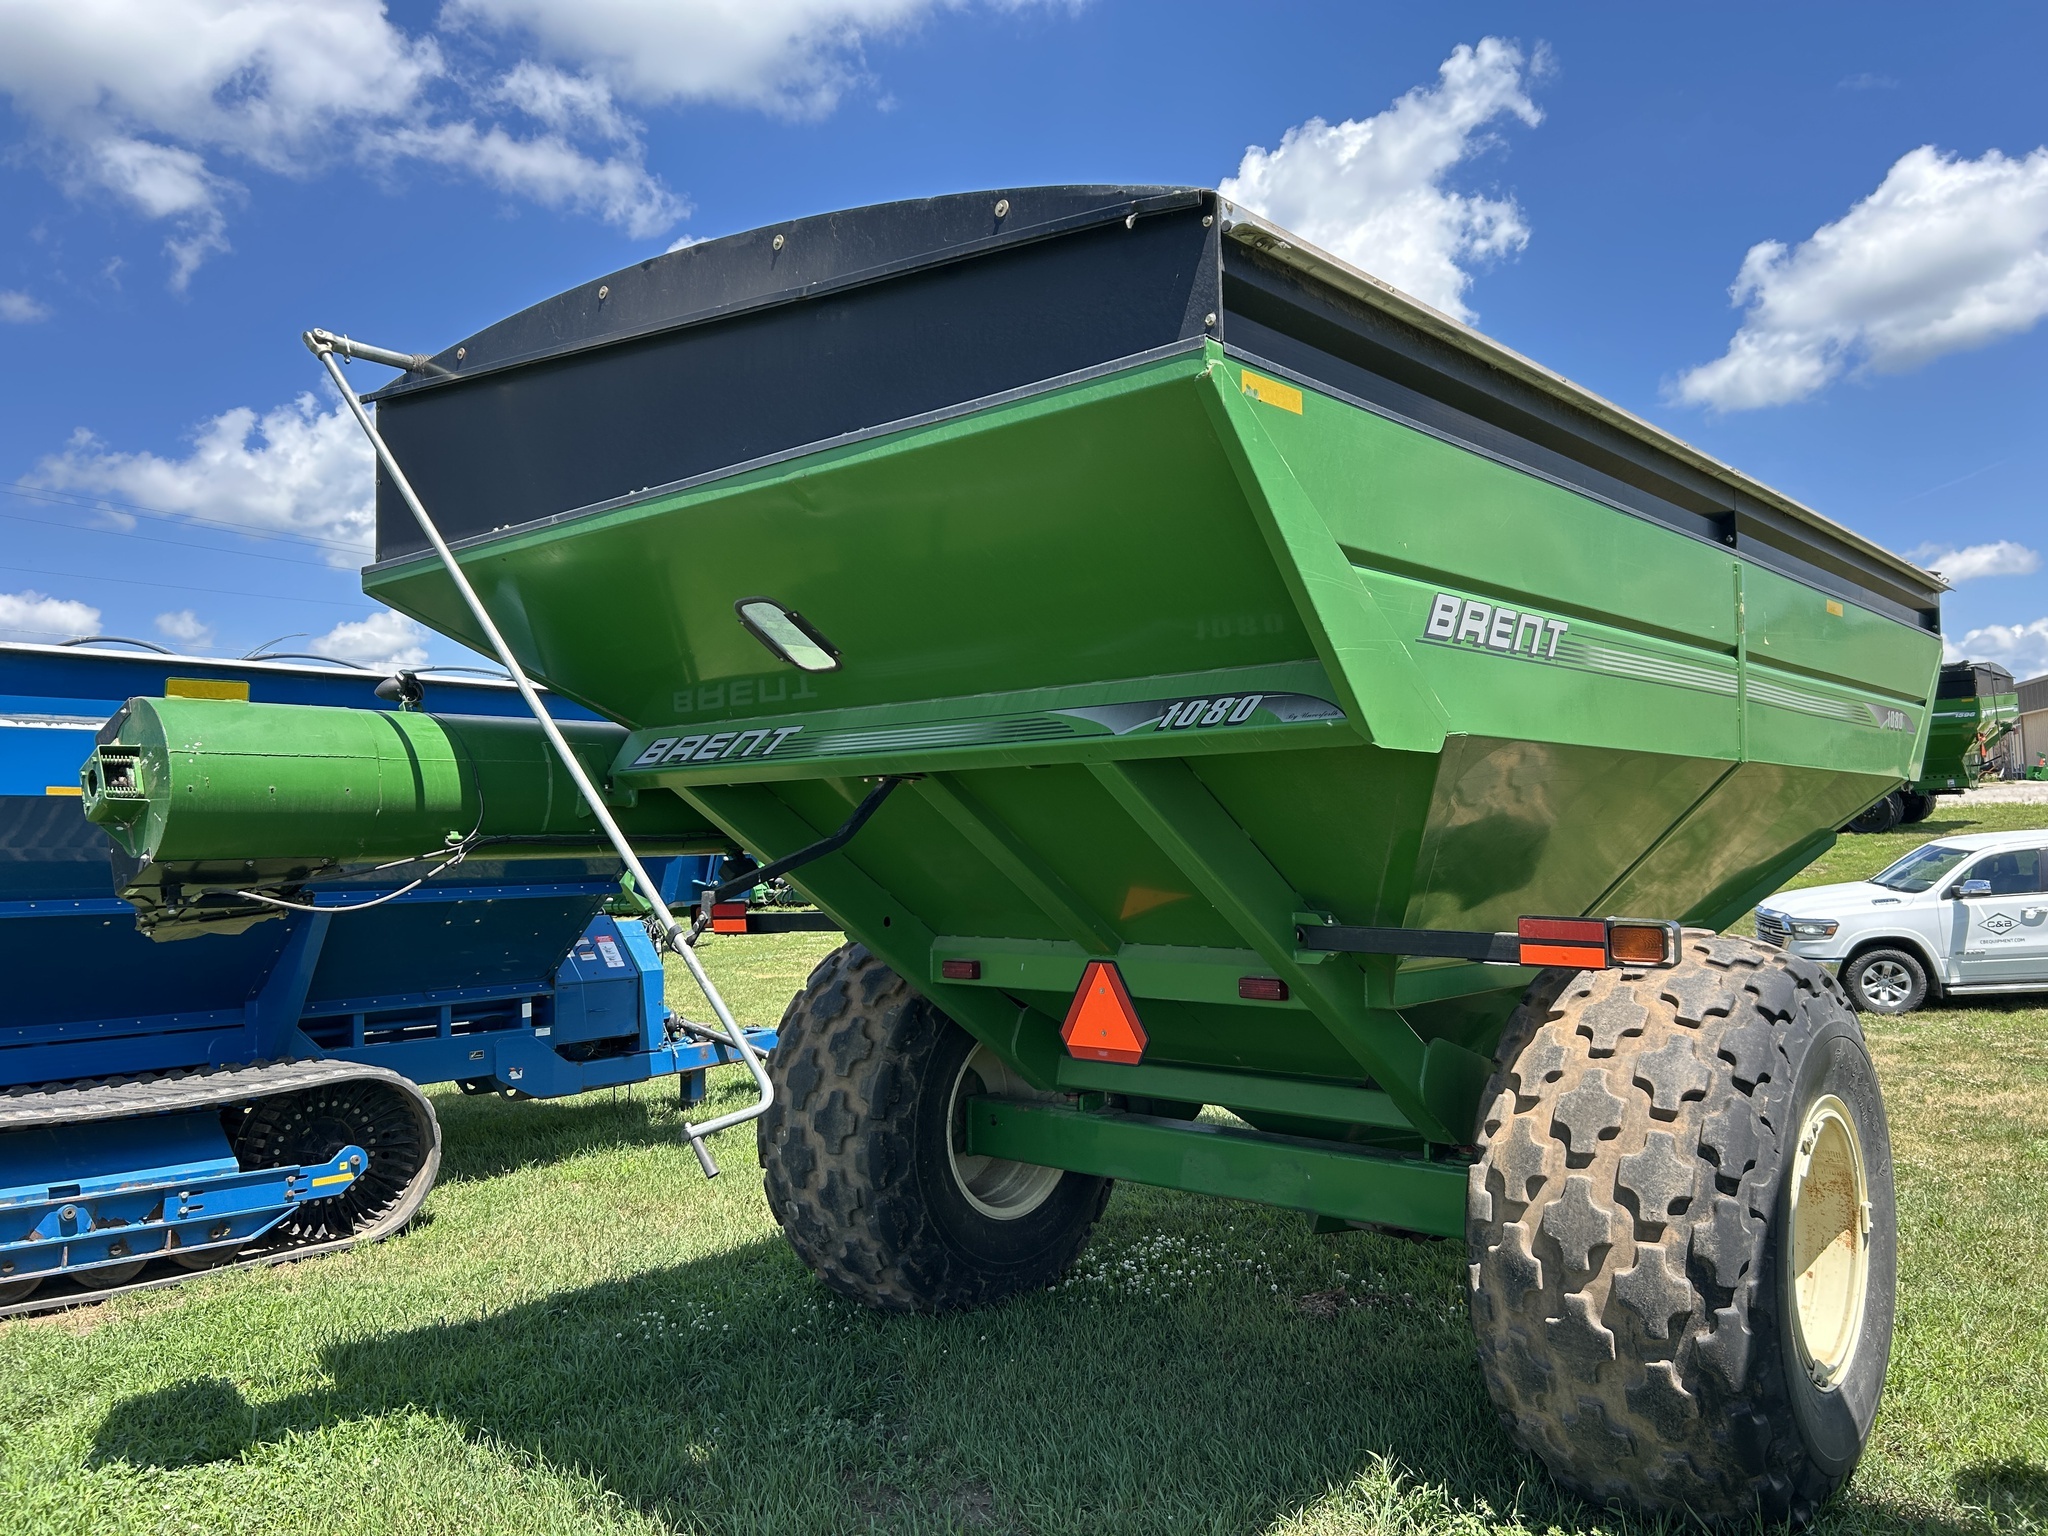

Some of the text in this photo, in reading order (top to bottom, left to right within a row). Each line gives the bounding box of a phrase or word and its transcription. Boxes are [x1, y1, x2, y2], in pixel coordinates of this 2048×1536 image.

[1424, 591, 1569, 660] BRENT
[629, 725, 805, 767] BRENT
[1154, 694, 1265, 731] 1080
[1887, 709, 1904, 731] 1080
[1987, 920, 2013, 928] C&B
